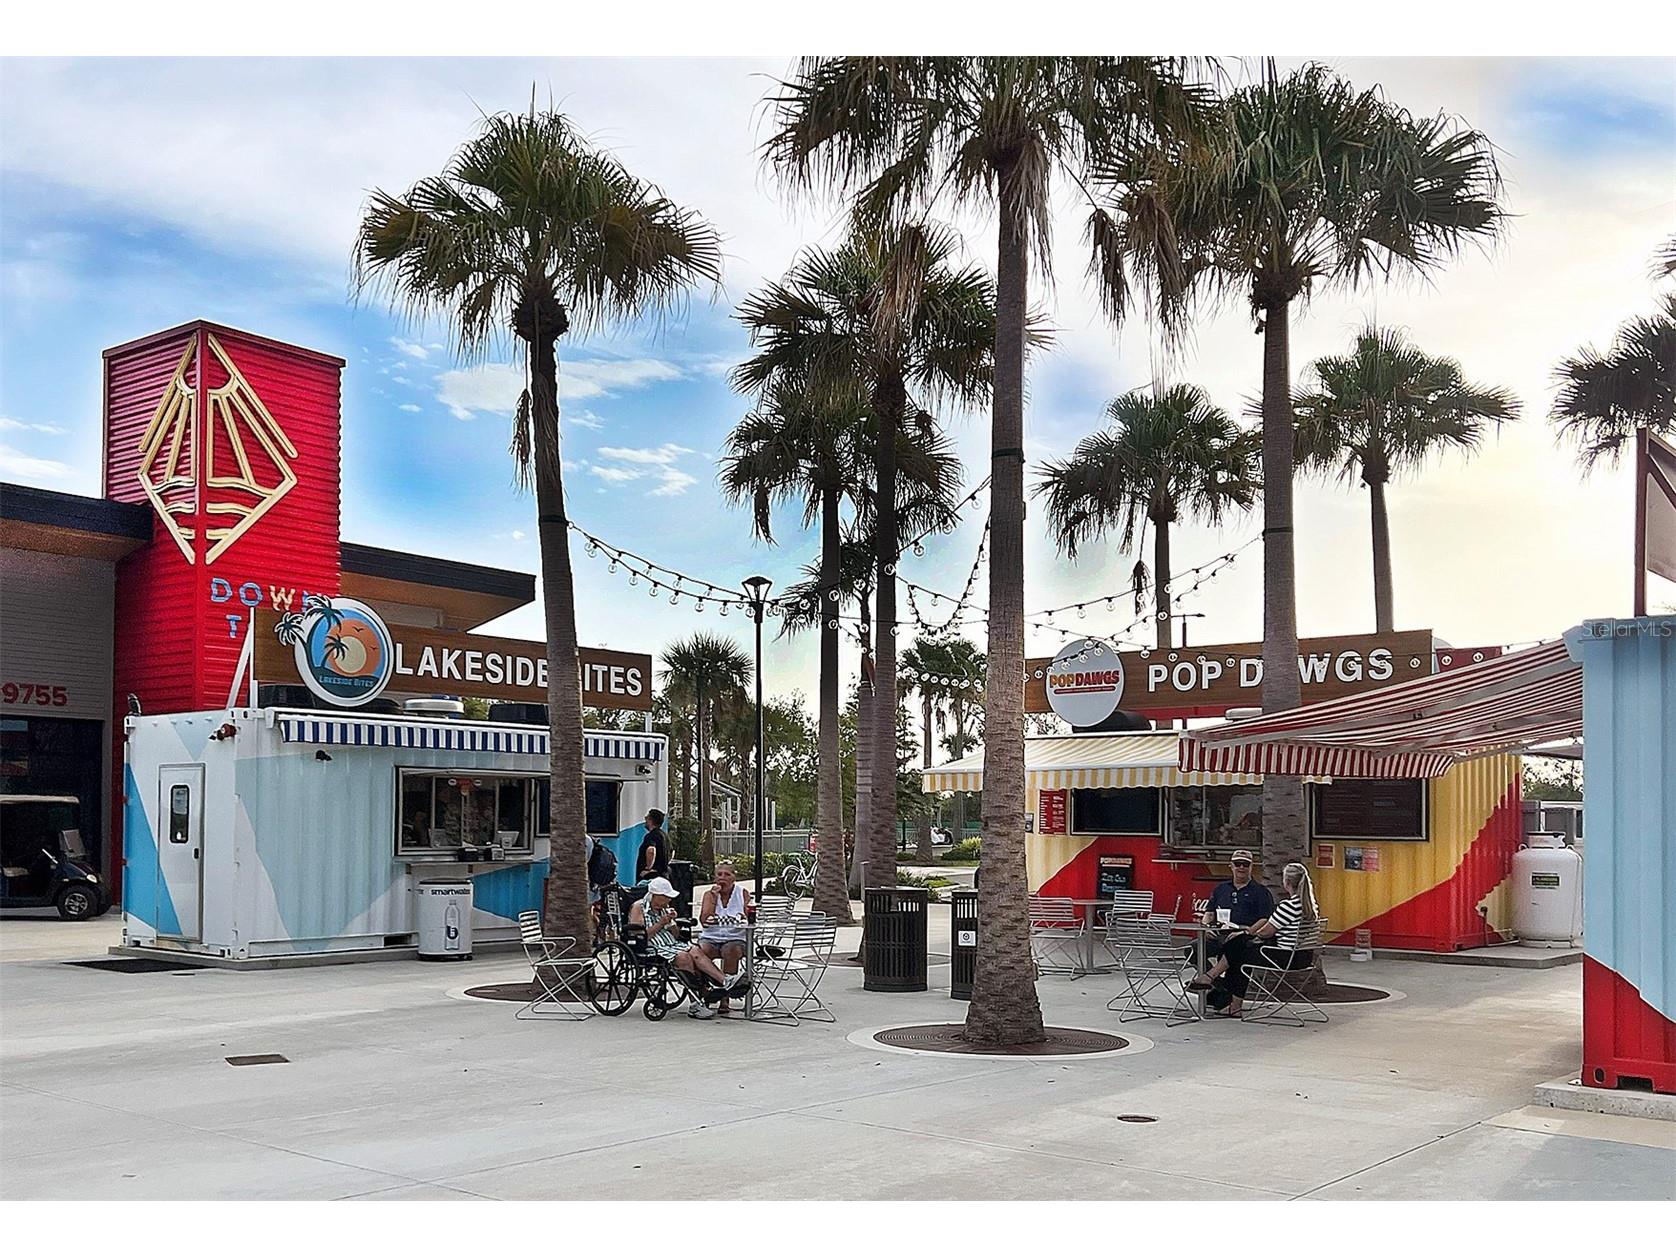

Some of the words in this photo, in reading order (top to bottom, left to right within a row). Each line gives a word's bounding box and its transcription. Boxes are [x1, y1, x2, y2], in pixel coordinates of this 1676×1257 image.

[395, 643, 548, 688] LAKESIDE
[583, 662, 643, 697] ITES
[1148, 660, 1223, 692] POP
[1240, 648, 1394, 688] DWGS
[1, 682, 68, 706] 9755
